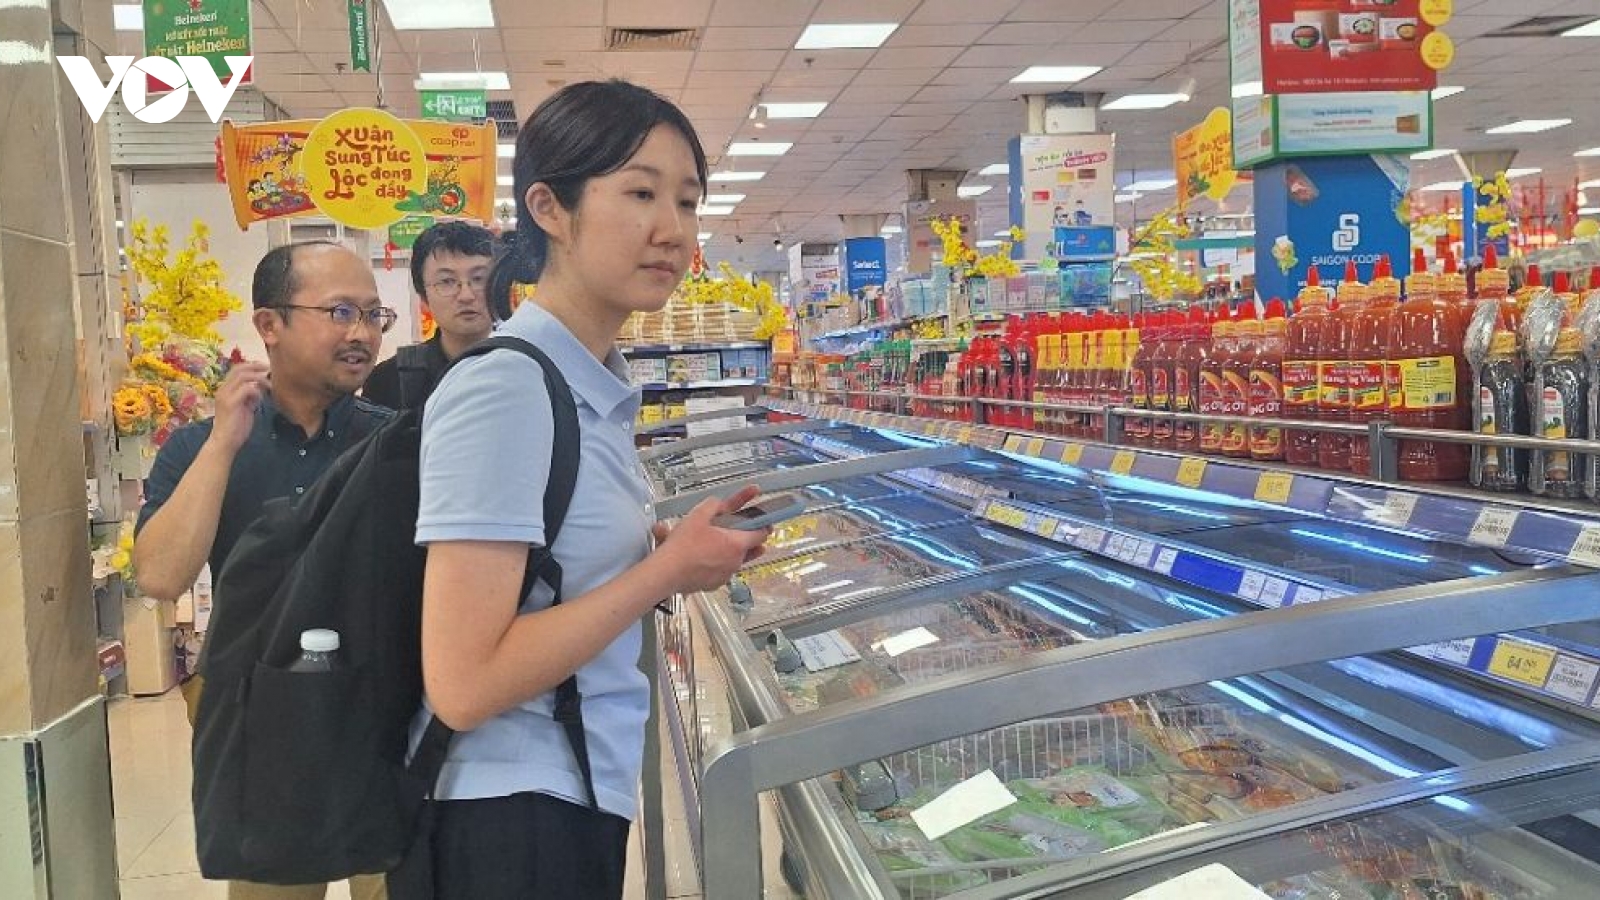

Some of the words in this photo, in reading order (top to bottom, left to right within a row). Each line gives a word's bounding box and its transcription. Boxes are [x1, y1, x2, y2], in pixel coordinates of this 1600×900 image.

[174, 10, 217, 25] Heineken
[186, 36, 246, 55] Heineken
[324, 150, 372, 168] Sung
[371, 143, 412, 164] Túc
[323, 168, 368, 200] Lộc
[852, 260, 880, 269] Select
[1311, 256, 1347, 266] SAIGON
